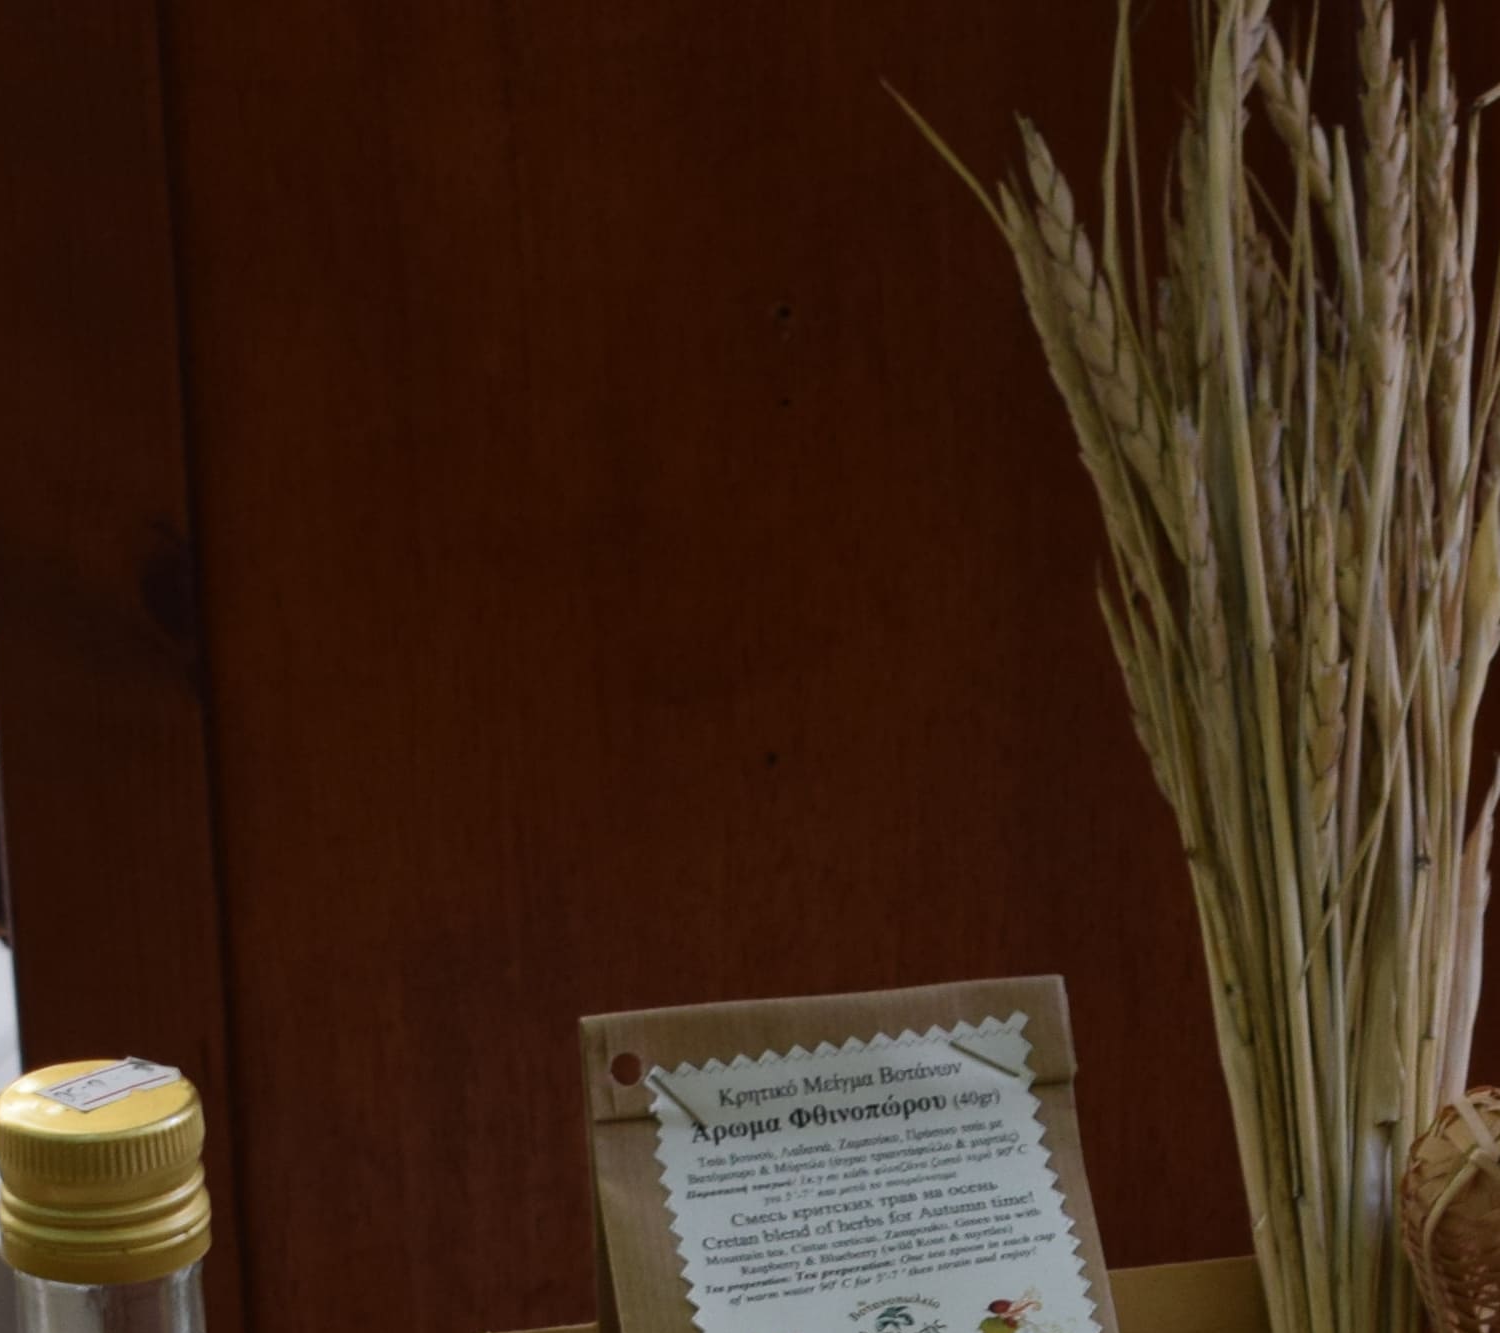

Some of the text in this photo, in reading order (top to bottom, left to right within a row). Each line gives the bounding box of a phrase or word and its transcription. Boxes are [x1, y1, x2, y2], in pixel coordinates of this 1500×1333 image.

[719, 1062, 960, 1108] Κρητικό Μείγμα Βοτάνων
[689, 1092, 999, 1144] Άρωμα Φθινοπώρου (40gr)
[701, 1235, 758, 1250] Cretan
[762, 1220, 810, 1242] blend
[815, 1220, 833, 1235] of
[836, 1215, 883, 1231] herbs
[888, 1206, 911, 1224] for
[919, 1201, 986, 1218] Autumn
[731, 1212, 786, 1226] Смесь
[878, 1192, 917, 1208] трав
[922, 1188, 943, 1199] на
